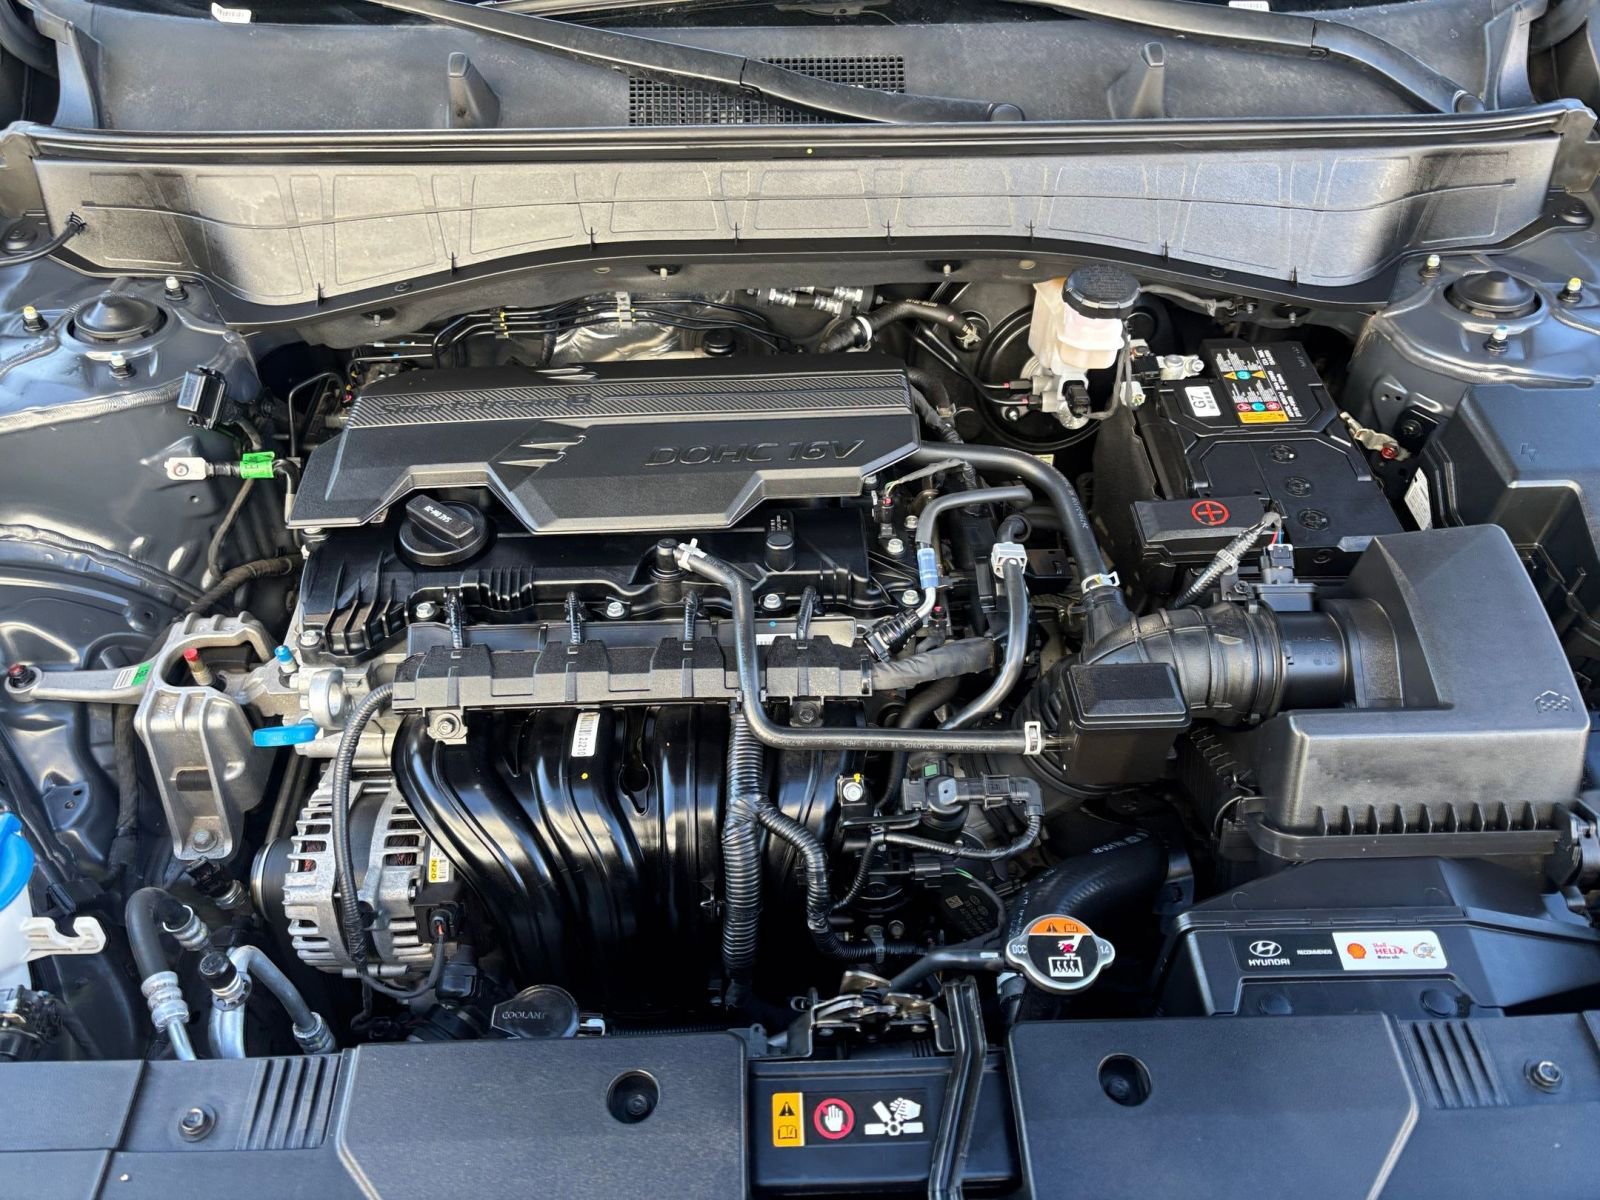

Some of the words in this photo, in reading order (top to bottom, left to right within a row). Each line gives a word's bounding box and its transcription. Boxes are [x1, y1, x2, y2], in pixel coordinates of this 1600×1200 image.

[644, 442, 779, 466] DOHC
[788, 439, 865, 461] 16V
[1248, 958, 1290, 967] HYUNDAI
[501, 1011, 545, 1020] COOLANT
